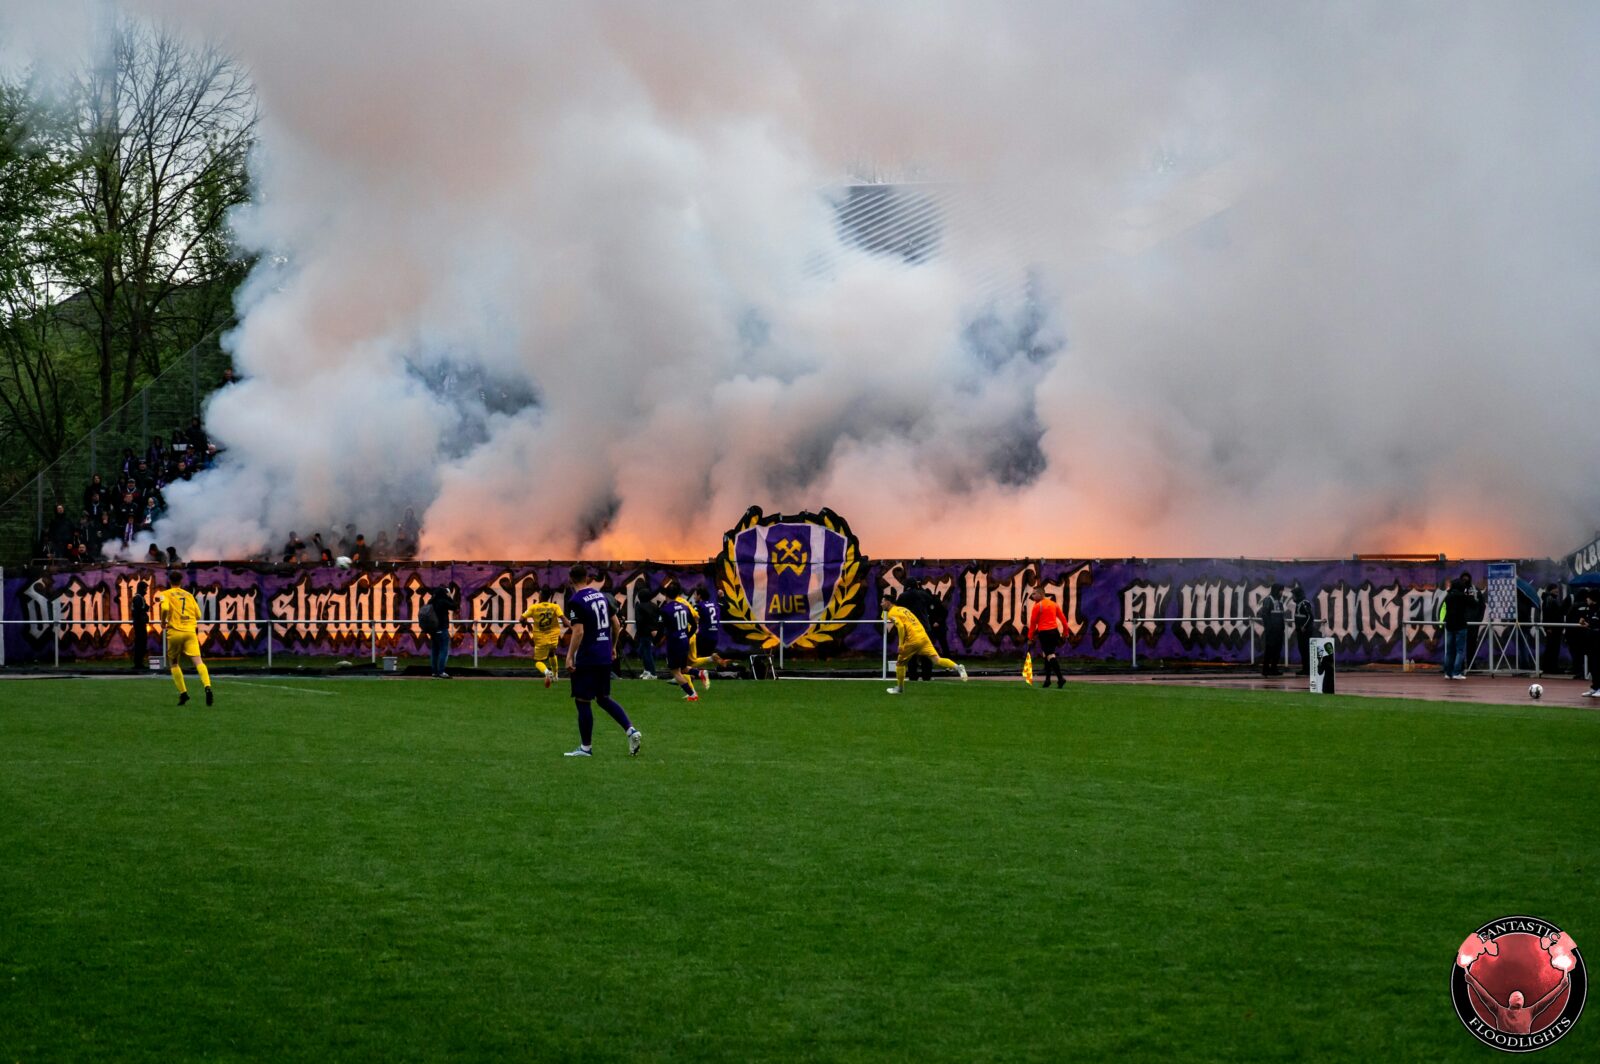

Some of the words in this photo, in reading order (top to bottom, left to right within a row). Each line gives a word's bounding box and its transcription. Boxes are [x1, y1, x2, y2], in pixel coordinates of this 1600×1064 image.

[1575, 539, 1600, 575] OLB
[179, 596, 186, 615] 7
[271, 573, 400, 640] strahlt
[768, 593, 807, 614] AUE
[591, 599, 610, 630] 13
[674, 610, 688, 631] 10
[709, 606, 718, 624] 2
